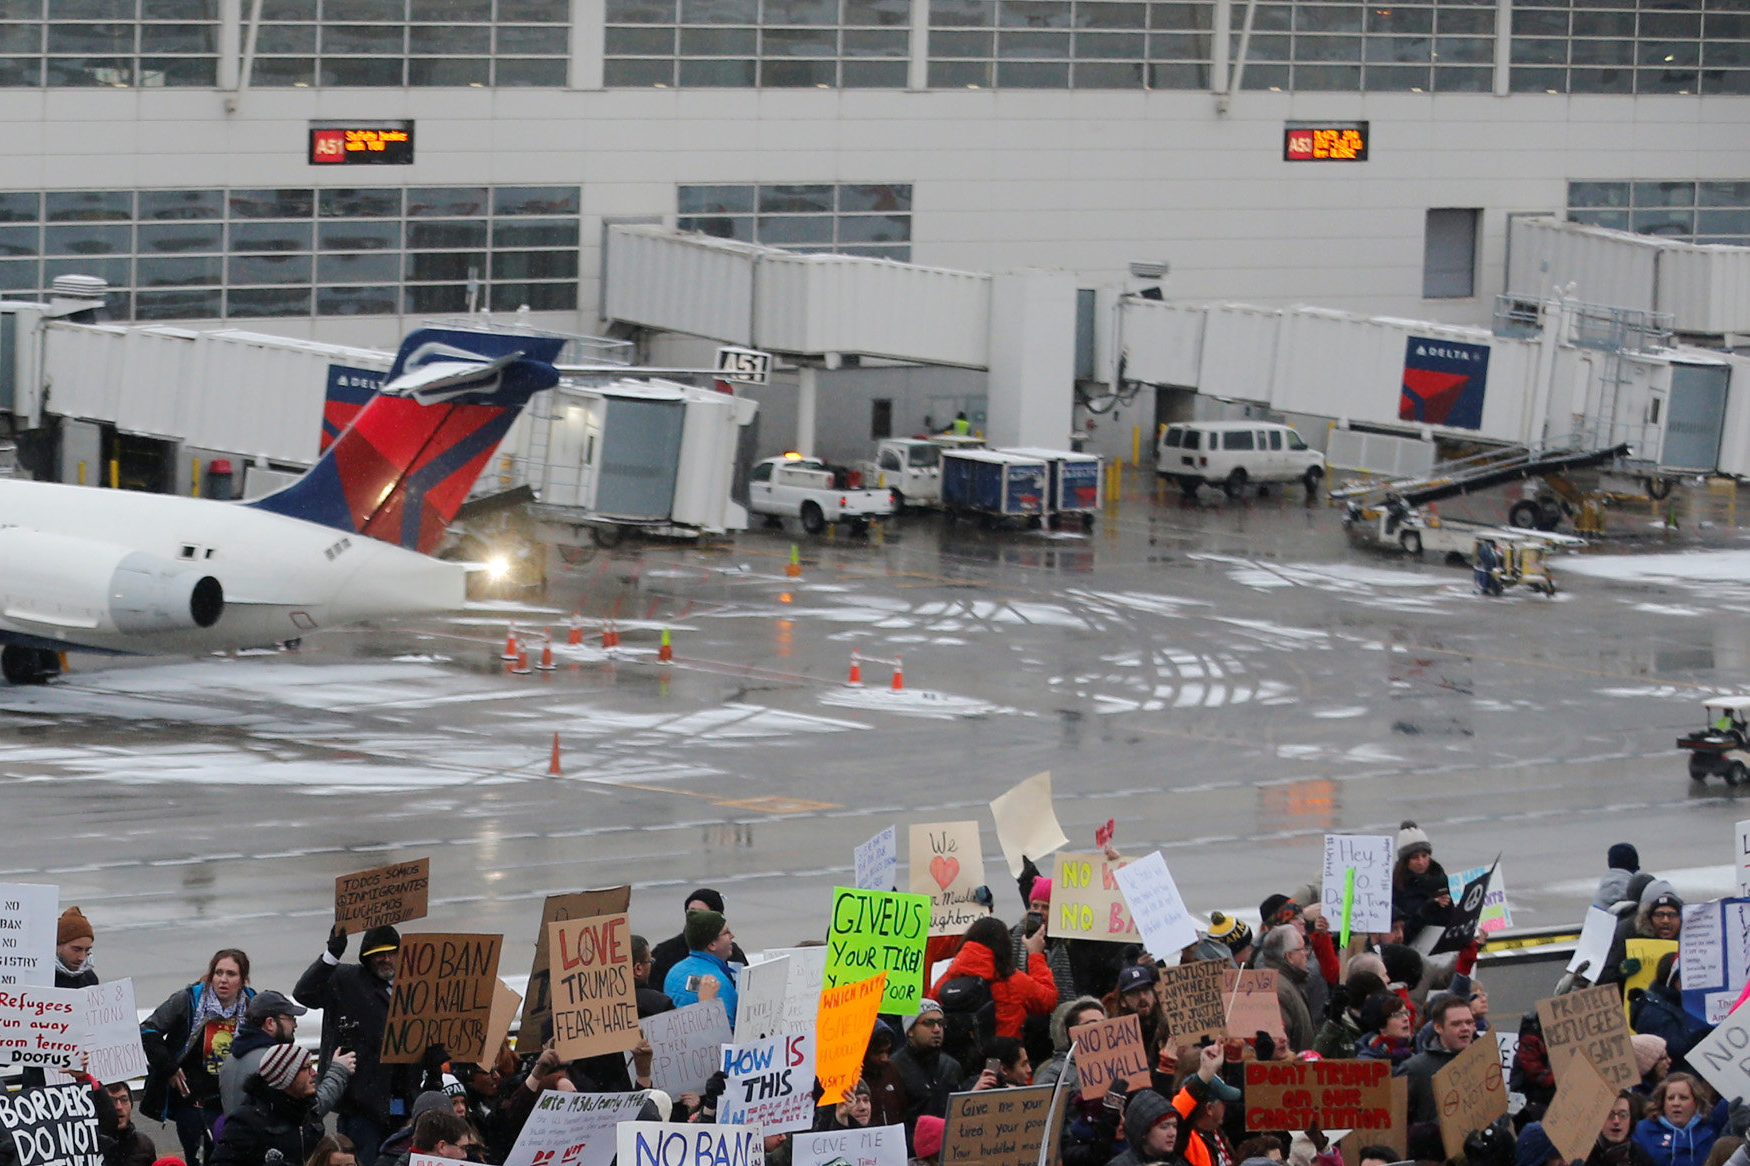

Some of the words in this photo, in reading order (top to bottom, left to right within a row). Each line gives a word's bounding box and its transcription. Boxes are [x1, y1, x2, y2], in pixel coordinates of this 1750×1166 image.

[316, 136, 344, 155] A51
[1289, 137, 1312, 153] A53
[721, 351, 767, 382] A51
[1429, 347, 1470, 360] DELTA
[343, 875, 380, 892] TODOS
[386, 865, 419, 879] SOMOS
[1062, 861, 1092, 889] NO
[4, 900, 20, 912] NO
[1059, 903, 1093, 931] NO
[0, 918, 22, 930] BAN
[2, 937, 18, 949] NO
[559, 918, 627, 970] LOVE
[399, 943, 435, 979] NO
[439, 940, 494, 979] BAN
[833, 943, 878, 970] YOUR
[883, 948, 924, 979] TIRED
[392, 980, 429, 1017] NO
[434, 979, 488, 1013] WALL
[561, 965, 627, 1004] TRUMPS
[29, 1021, 70, 1035] away
[383, 1018, 425, 1056] NO
[1077, 1030, 1100, 1055] NO
[1105, 1018, 1139, 1048] BAN
[1547, 1005, 1626, 1046] REFUGEES
[11, 1049, 72, 1068] DOOFUS
[724, 1045, 774, 1076] HOW
[786, 1036, 805, 1067] IS
[742, 1069, 793, 1102] THIS
[1080, 1064, 1102, 1087] NO
[1313, 1061, 1388, 1087] TRUMP
[962, 1098, 988, 1116] Give
[58, 1119, 100, 1152] NOT
[980, 1142, 1016, 1156] huddled
